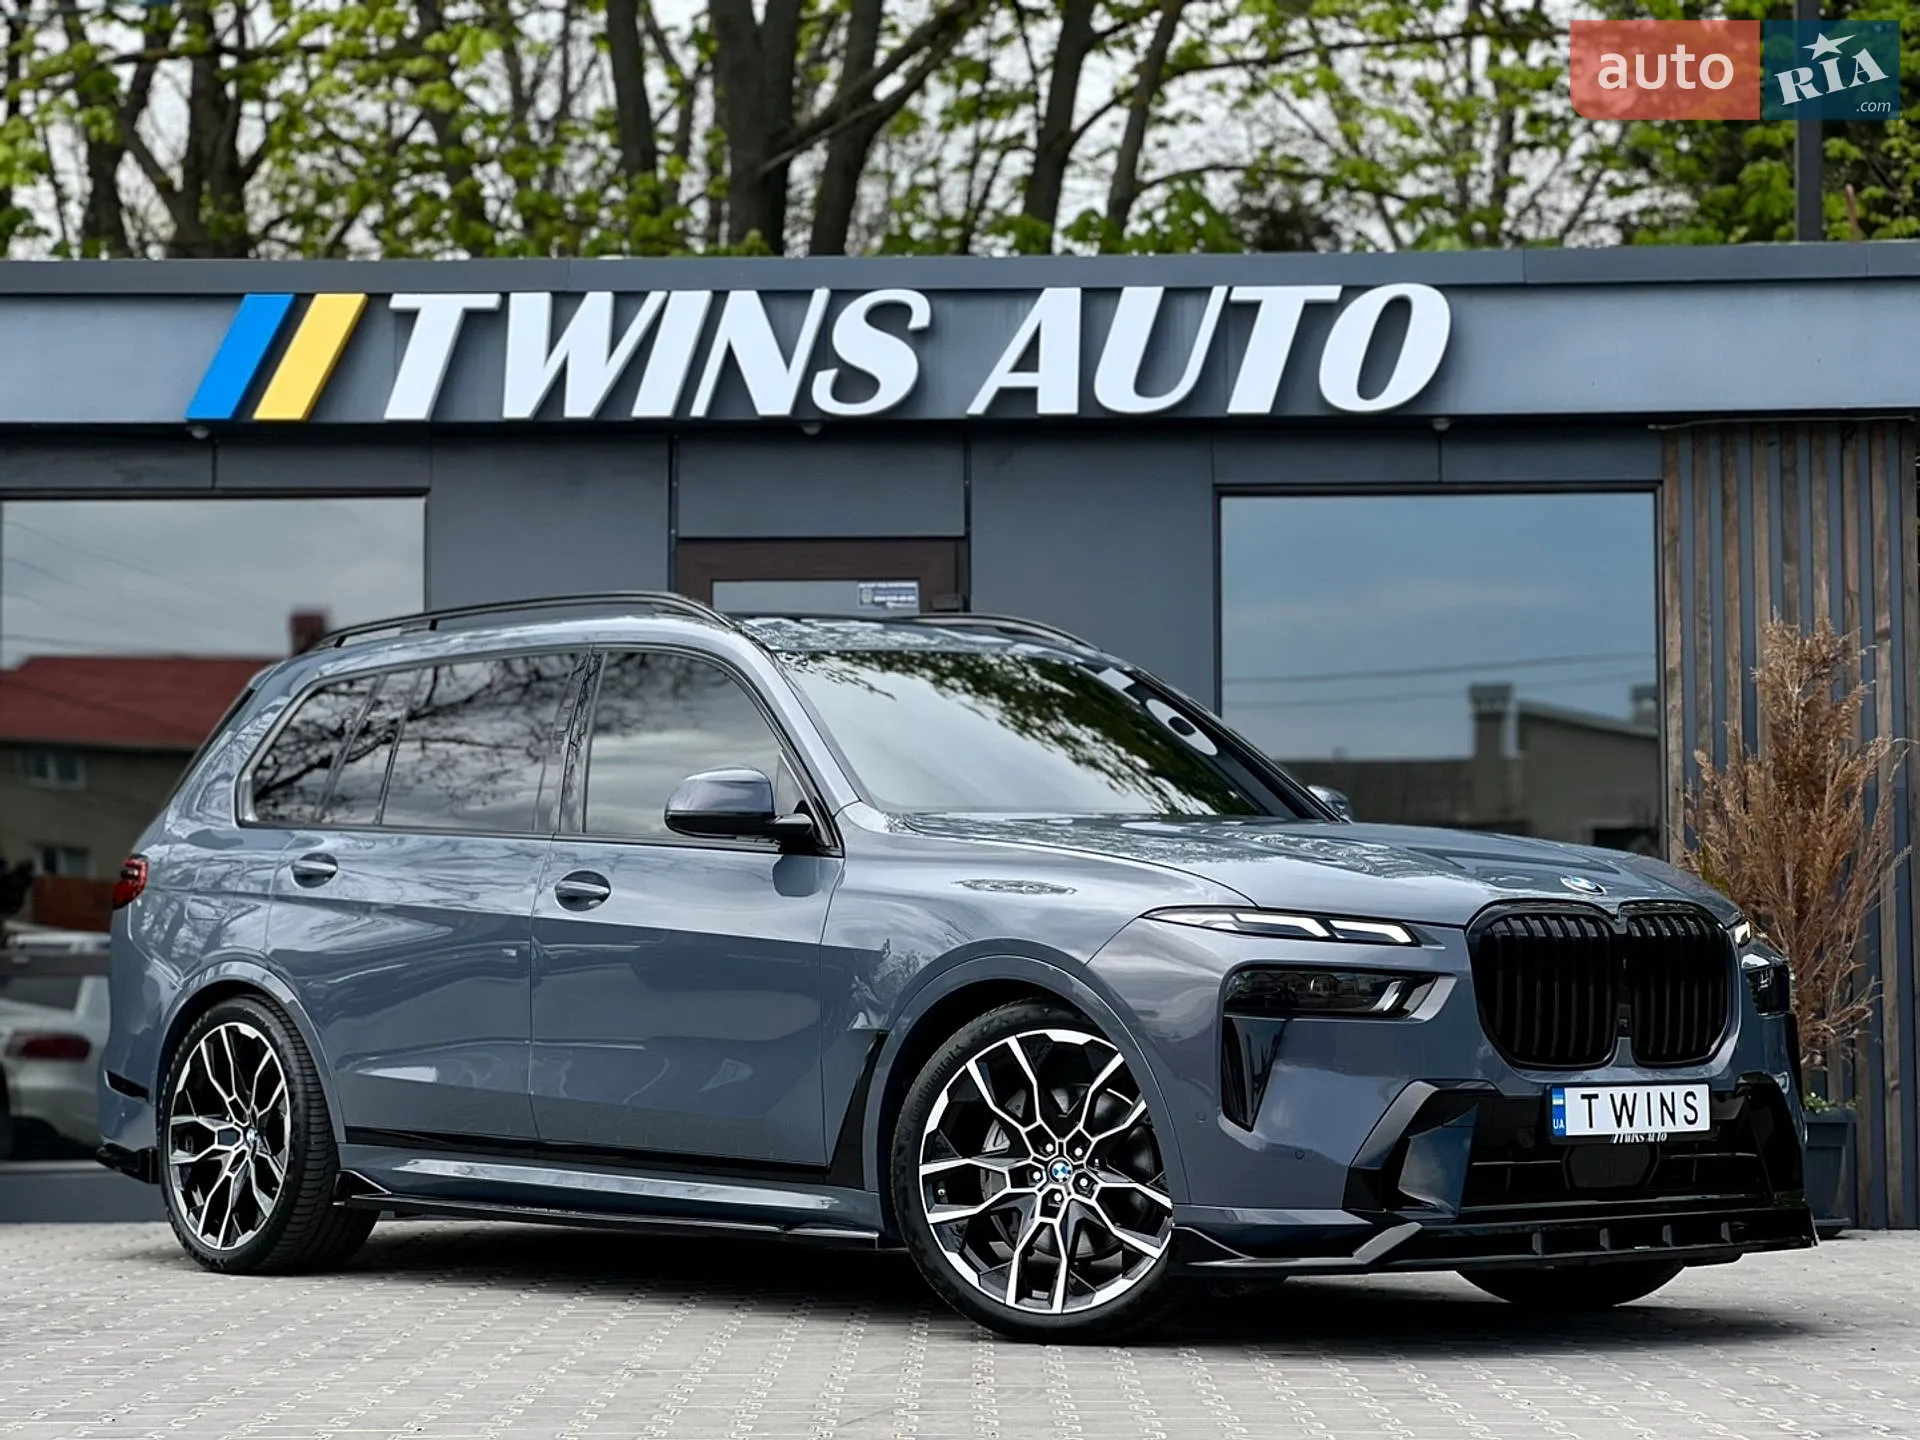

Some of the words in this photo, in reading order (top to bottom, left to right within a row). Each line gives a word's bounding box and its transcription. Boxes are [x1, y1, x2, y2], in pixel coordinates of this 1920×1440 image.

[384, 289, 930, 420] TWINS
[966, 283, 1451, 417] AUTO
[1553, 1118, 1565, 1129] UA
[1580, 1090, 1699, 1129] TWINS
